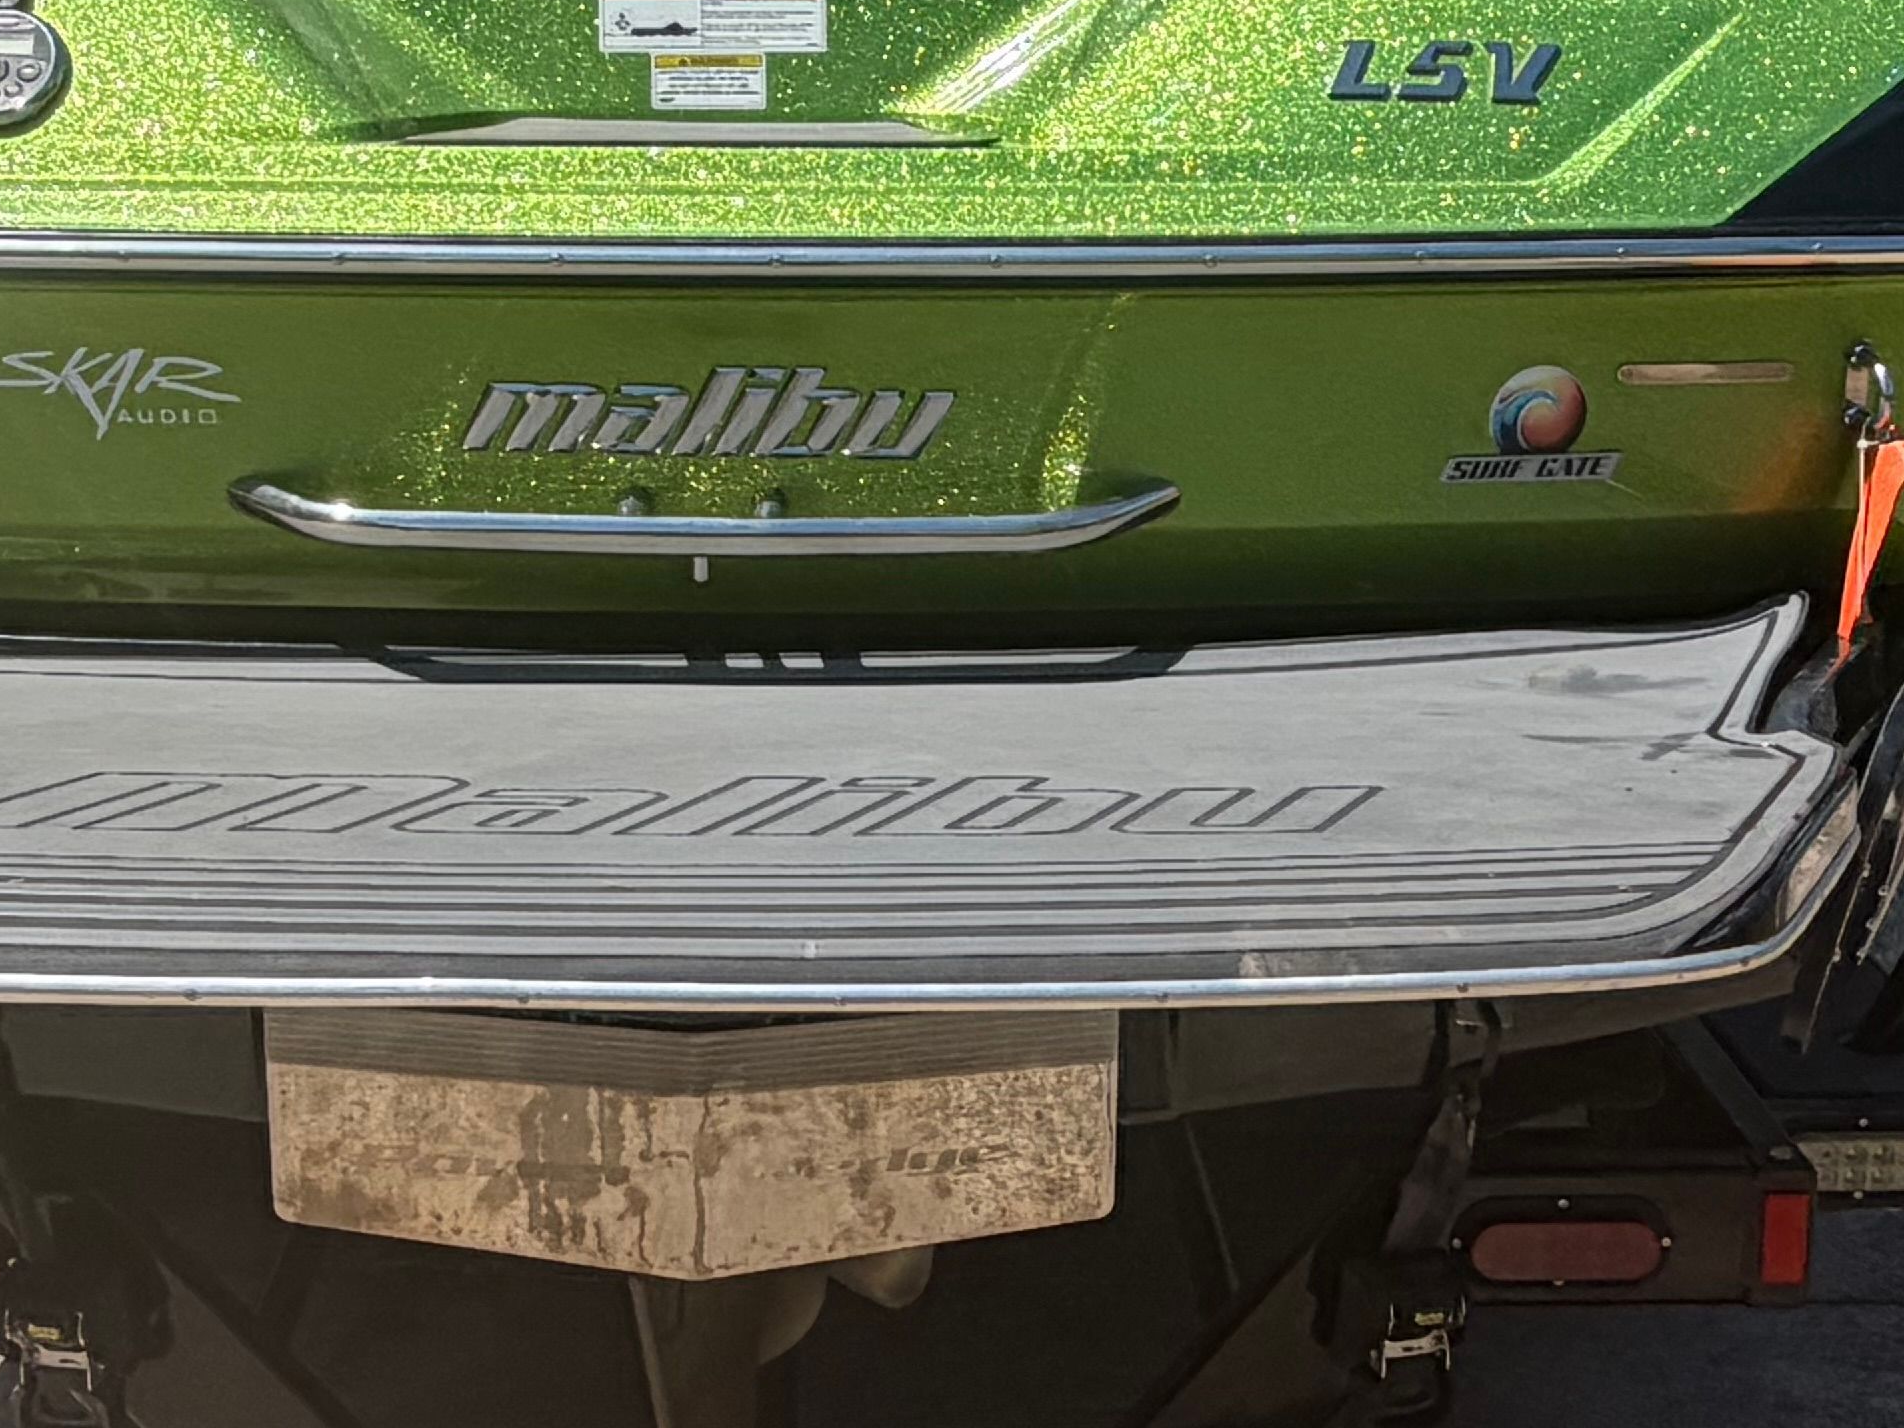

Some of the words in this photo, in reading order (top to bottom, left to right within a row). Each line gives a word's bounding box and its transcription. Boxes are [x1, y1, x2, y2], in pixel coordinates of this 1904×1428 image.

[1328, 40, 1563, 104] LSV
[117, 408, 217, 424] AUDIO
[462, 367, 955, 458] malibu
[1446, 458, 1530, 480] SURF
[1535, 454, 1613, 478] GATE
